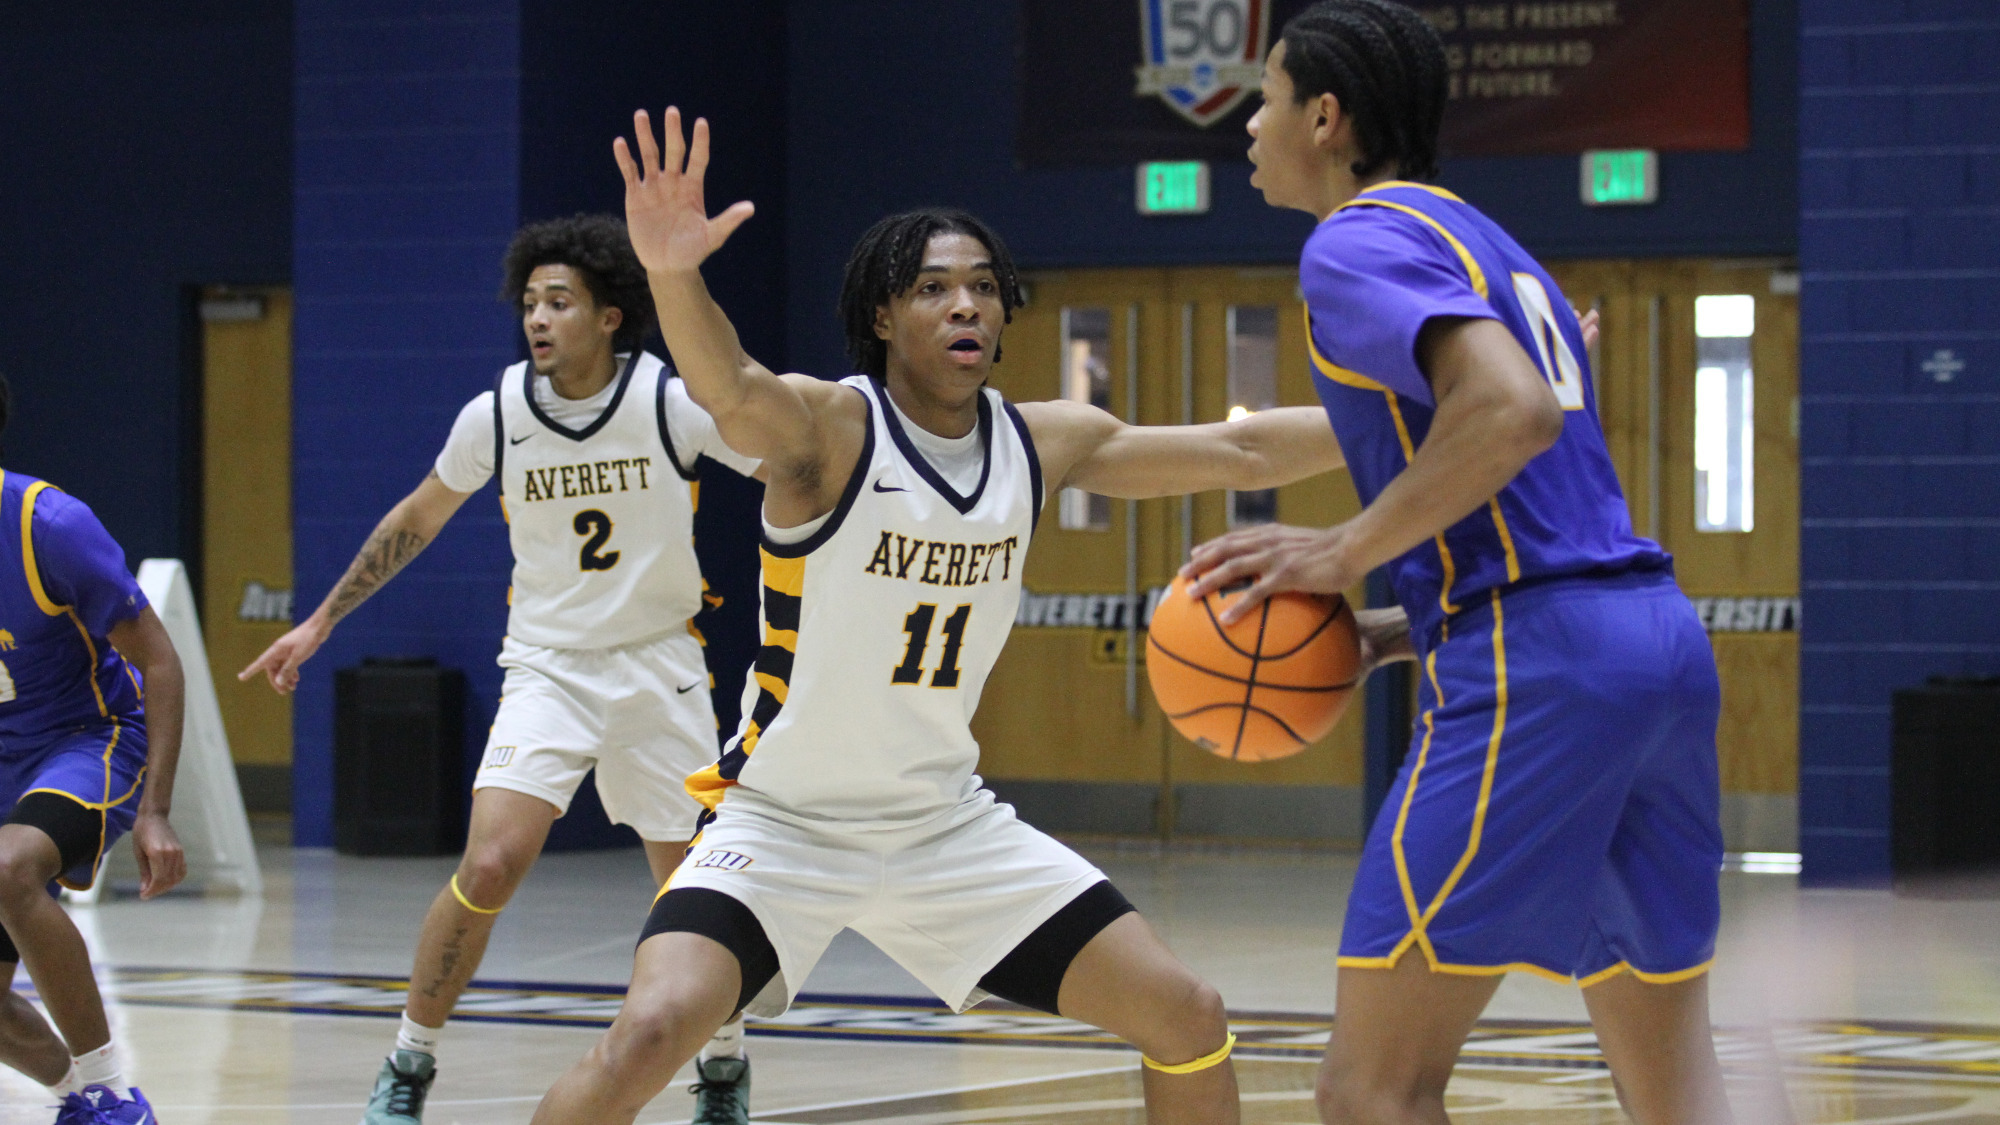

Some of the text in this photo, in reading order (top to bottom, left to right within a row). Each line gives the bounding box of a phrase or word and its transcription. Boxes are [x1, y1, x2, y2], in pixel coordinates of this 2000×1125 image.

[1169, 0, 1242, 58] 50
[1465, 5, 1506, 30] THE
[1471, 40, 1593, 69] FORWARD
[1146, 162, 1198, 210] EXIT
[1594, 150, 1646, 202] EXIT
[1511, 271, 1585, 411] 0
[525, 456, 650, 502] AVERETT
[572, 508, 621, 572] 2
[864, 529, 1018, 587] AVERETT
[889, 601, 973, 690] 11
[694, 849, 755, 872] AU
